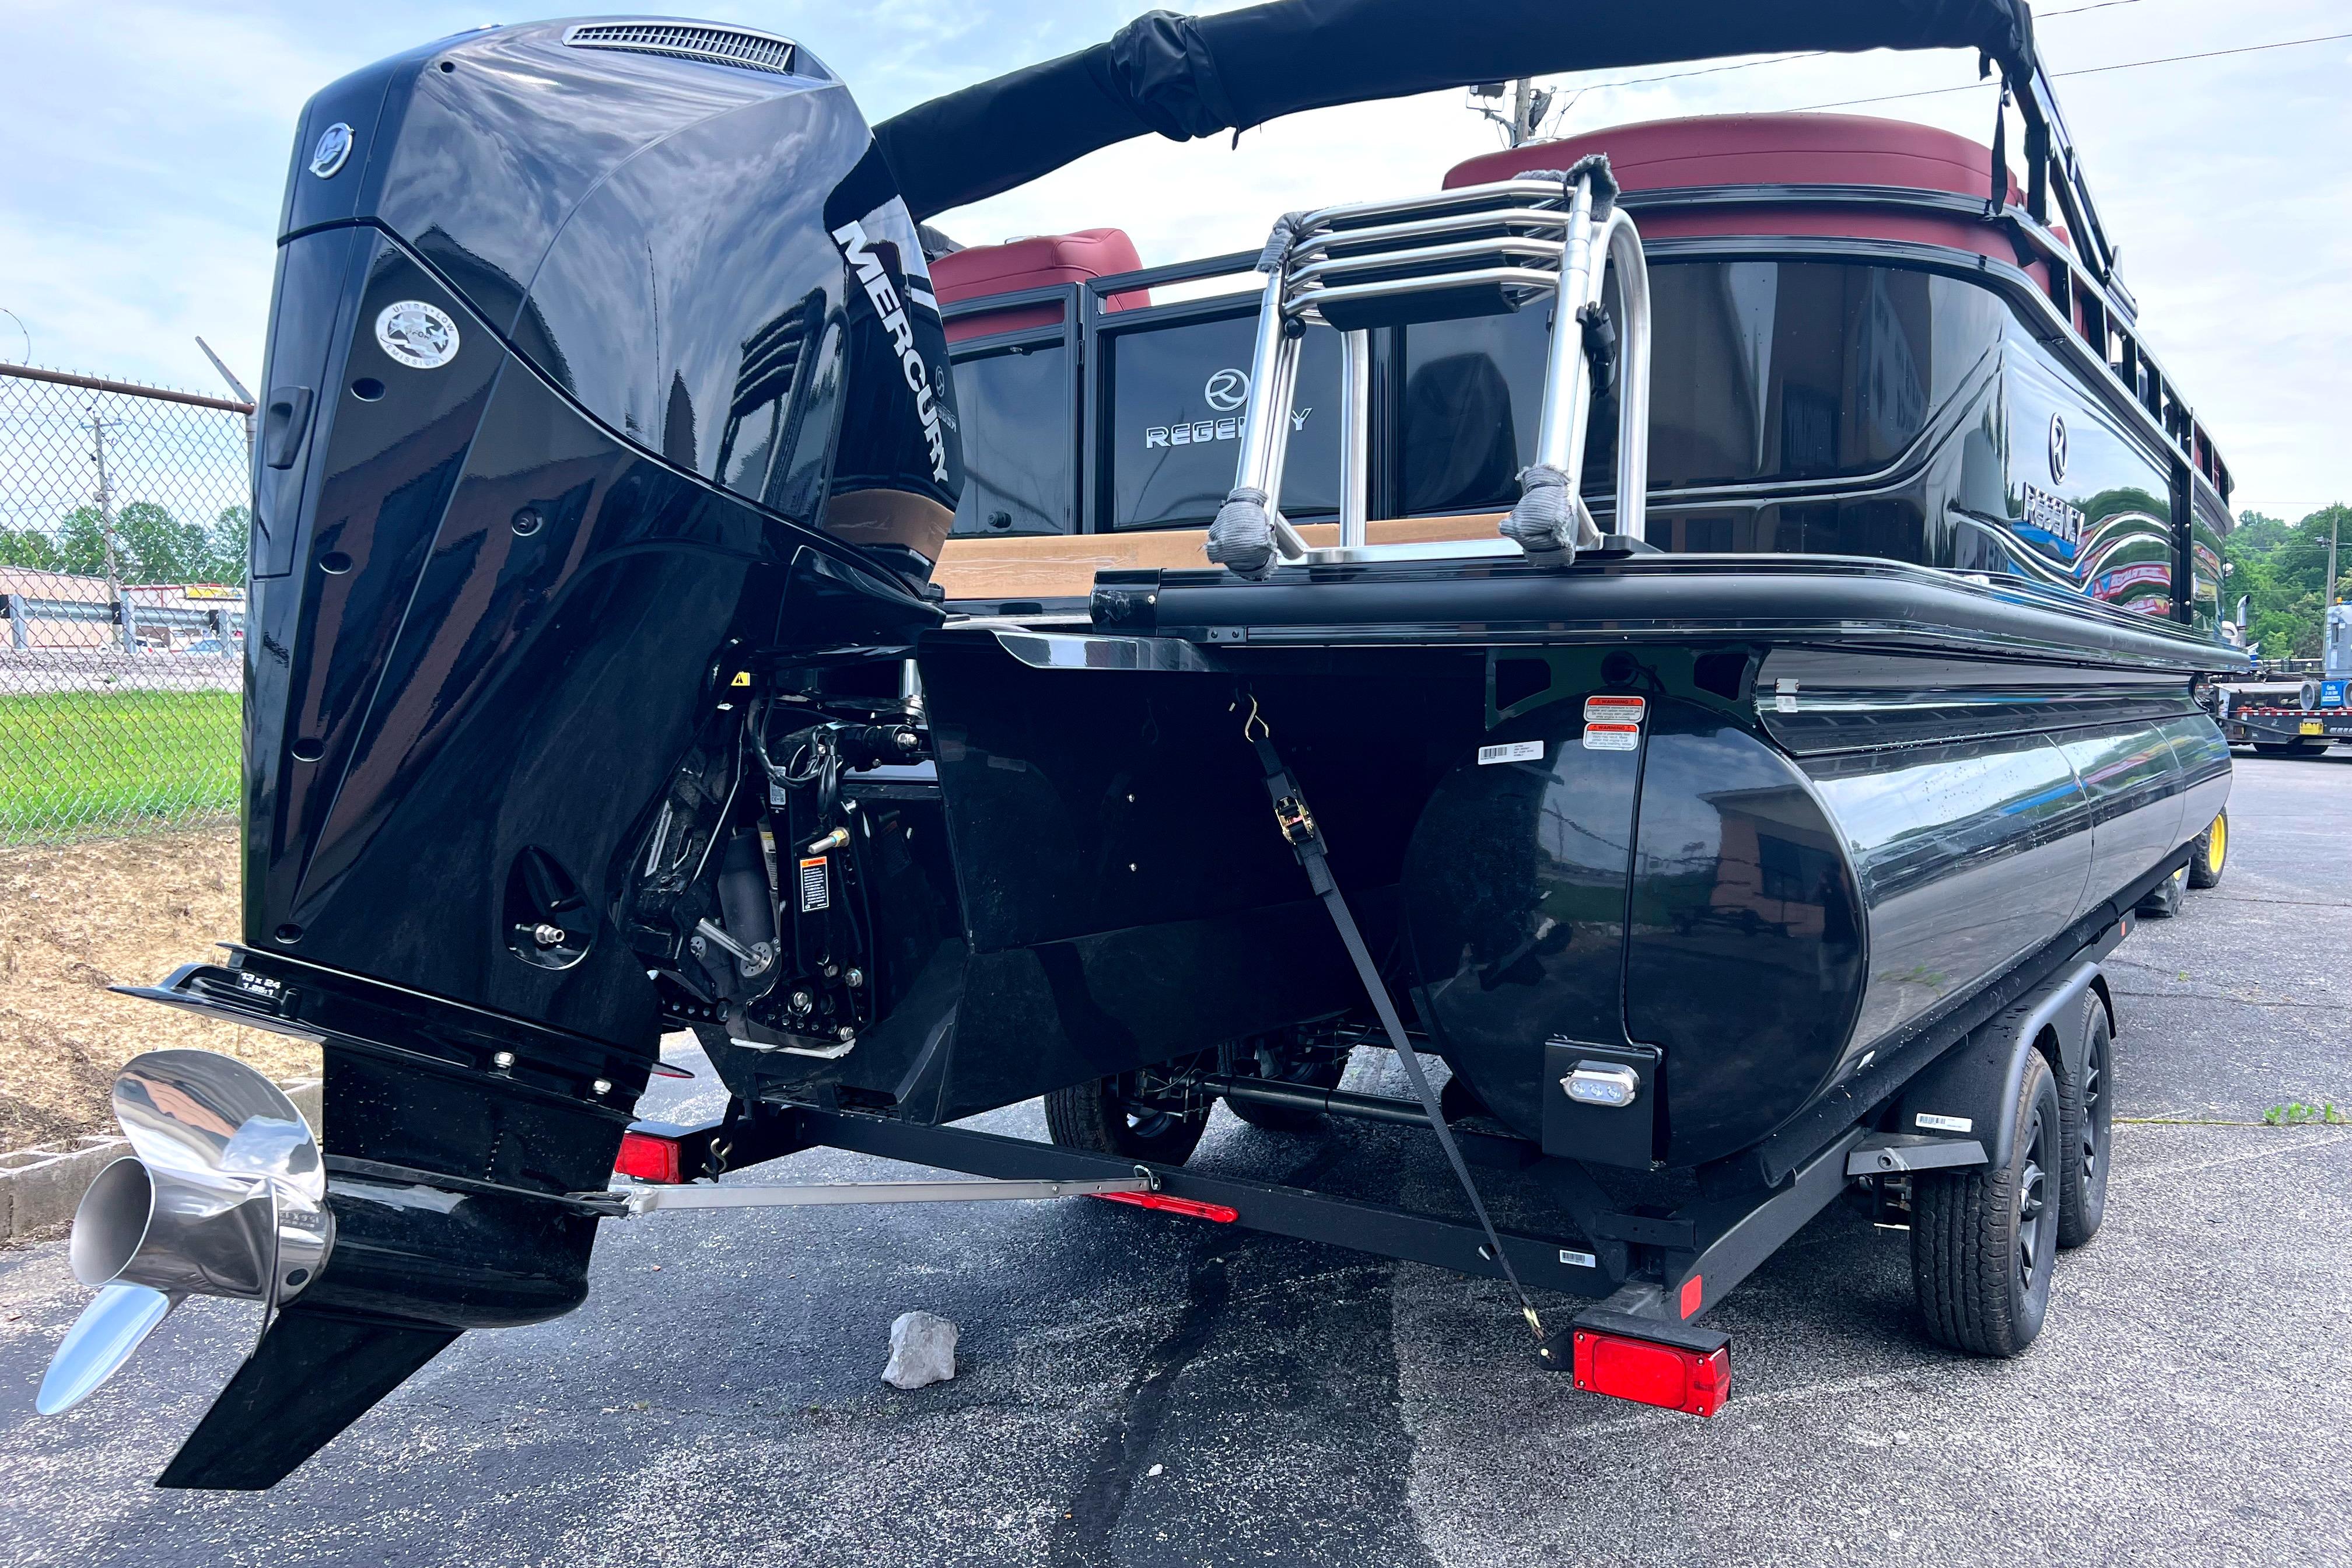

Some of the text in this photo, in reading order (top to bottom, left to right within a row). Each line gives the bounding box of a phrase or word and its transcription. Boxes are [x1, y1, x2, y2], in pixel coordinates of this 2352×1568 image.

[393, 303, 455, 332] ULTRA LOW
[386, 345, 439, 366] EMISSION
[832, 219, 949, 483] MERCURY
[1146, 407, 1312, 449] REGEY
[2021, 482, 2085, 545] REGENCY
[241, 972, 256, 982] 13
[264, 979, 281, 989] 24
[243, 982, 274, 996] 1.85:1
